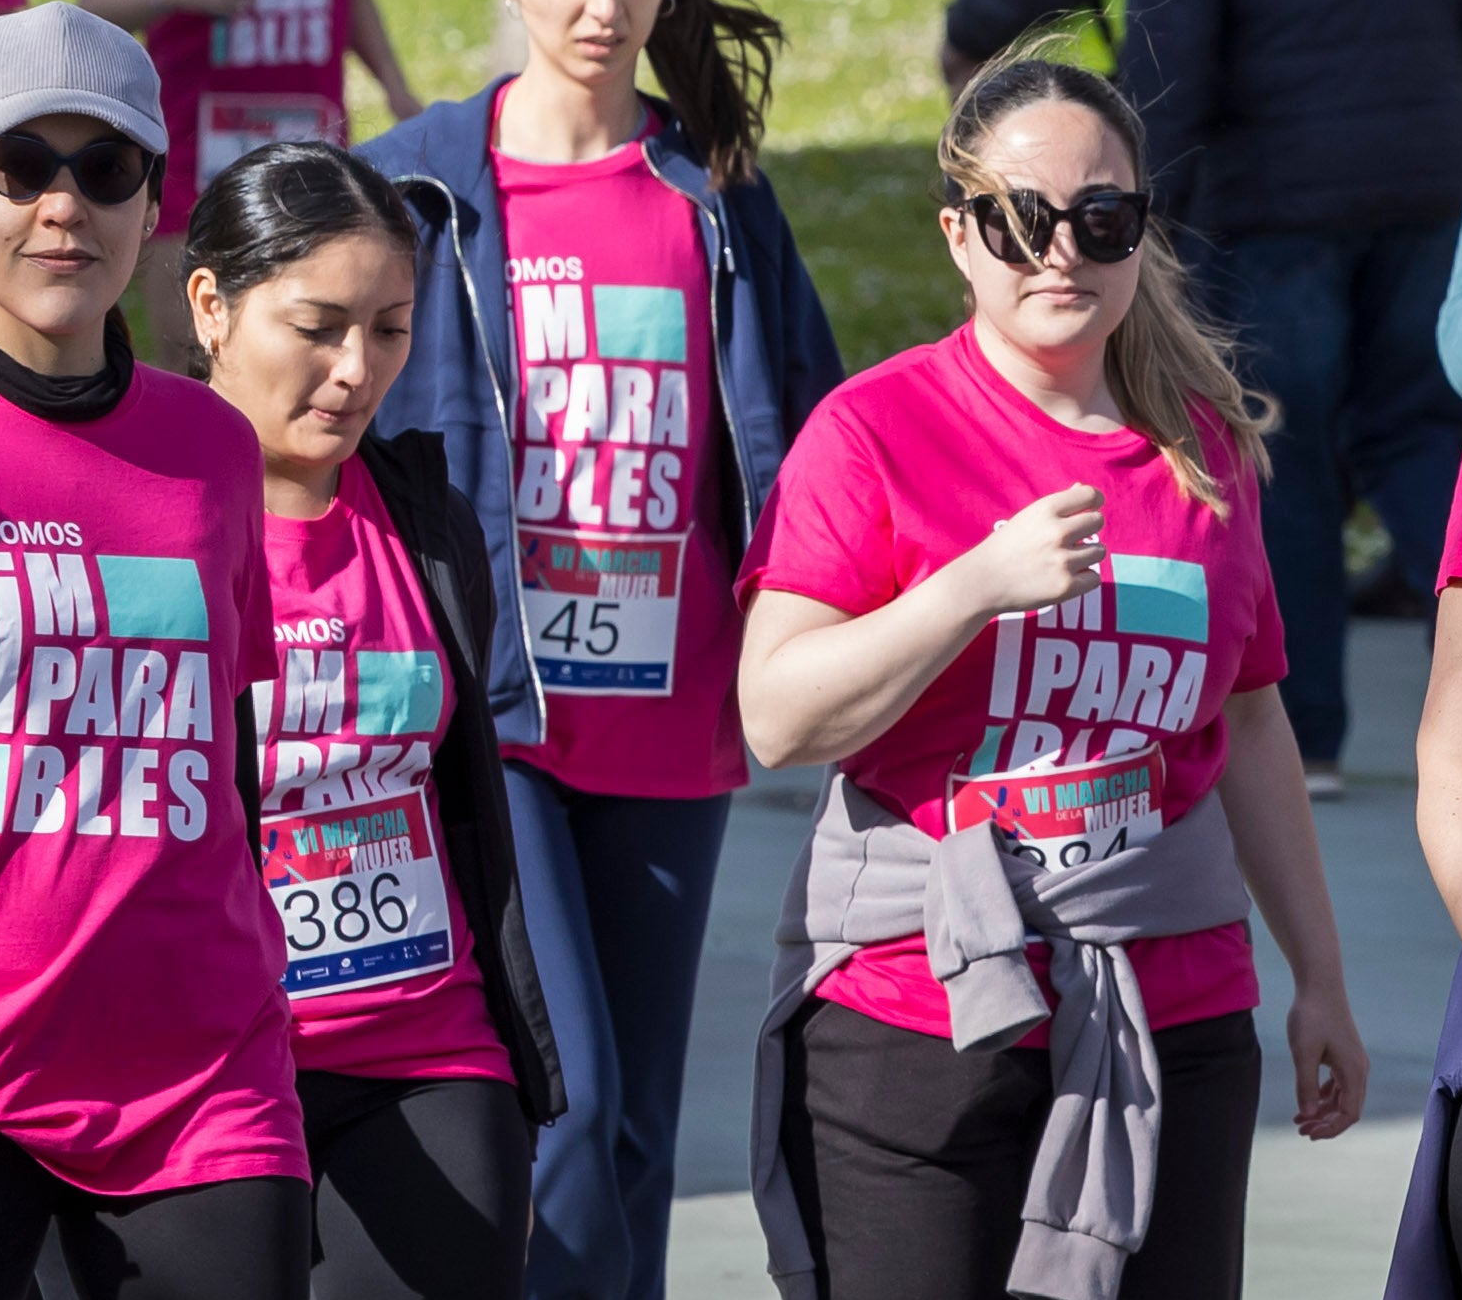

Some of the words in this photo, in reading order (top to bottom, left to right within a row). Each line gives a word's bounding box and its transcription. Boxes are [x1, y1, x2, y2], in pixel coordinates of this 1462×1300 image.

[505, 256, 584, 283] OMOS
[525, 363, 689, 447] PARA
[551, 545, 574, 569] VI
[579, 549, 660, 573] MARCHA
[598, 572, 659, 598] MUJER
[540, 599, 620, 656] 45
[25, 646, 213, 742] PARA
[1024, 637, 1208, 733] PARA
[1022, 786, 1049, 815] VI
[1055, 766, 1151, 811] MARCHA
[1084, 791, 1151, 832] MUJER
[292, 827, 319, 856] VI
[321, 808, 409, 850] MARCHA
[348, 836, 413, 875] MUJER
[284, 872, 408, 952] 386
